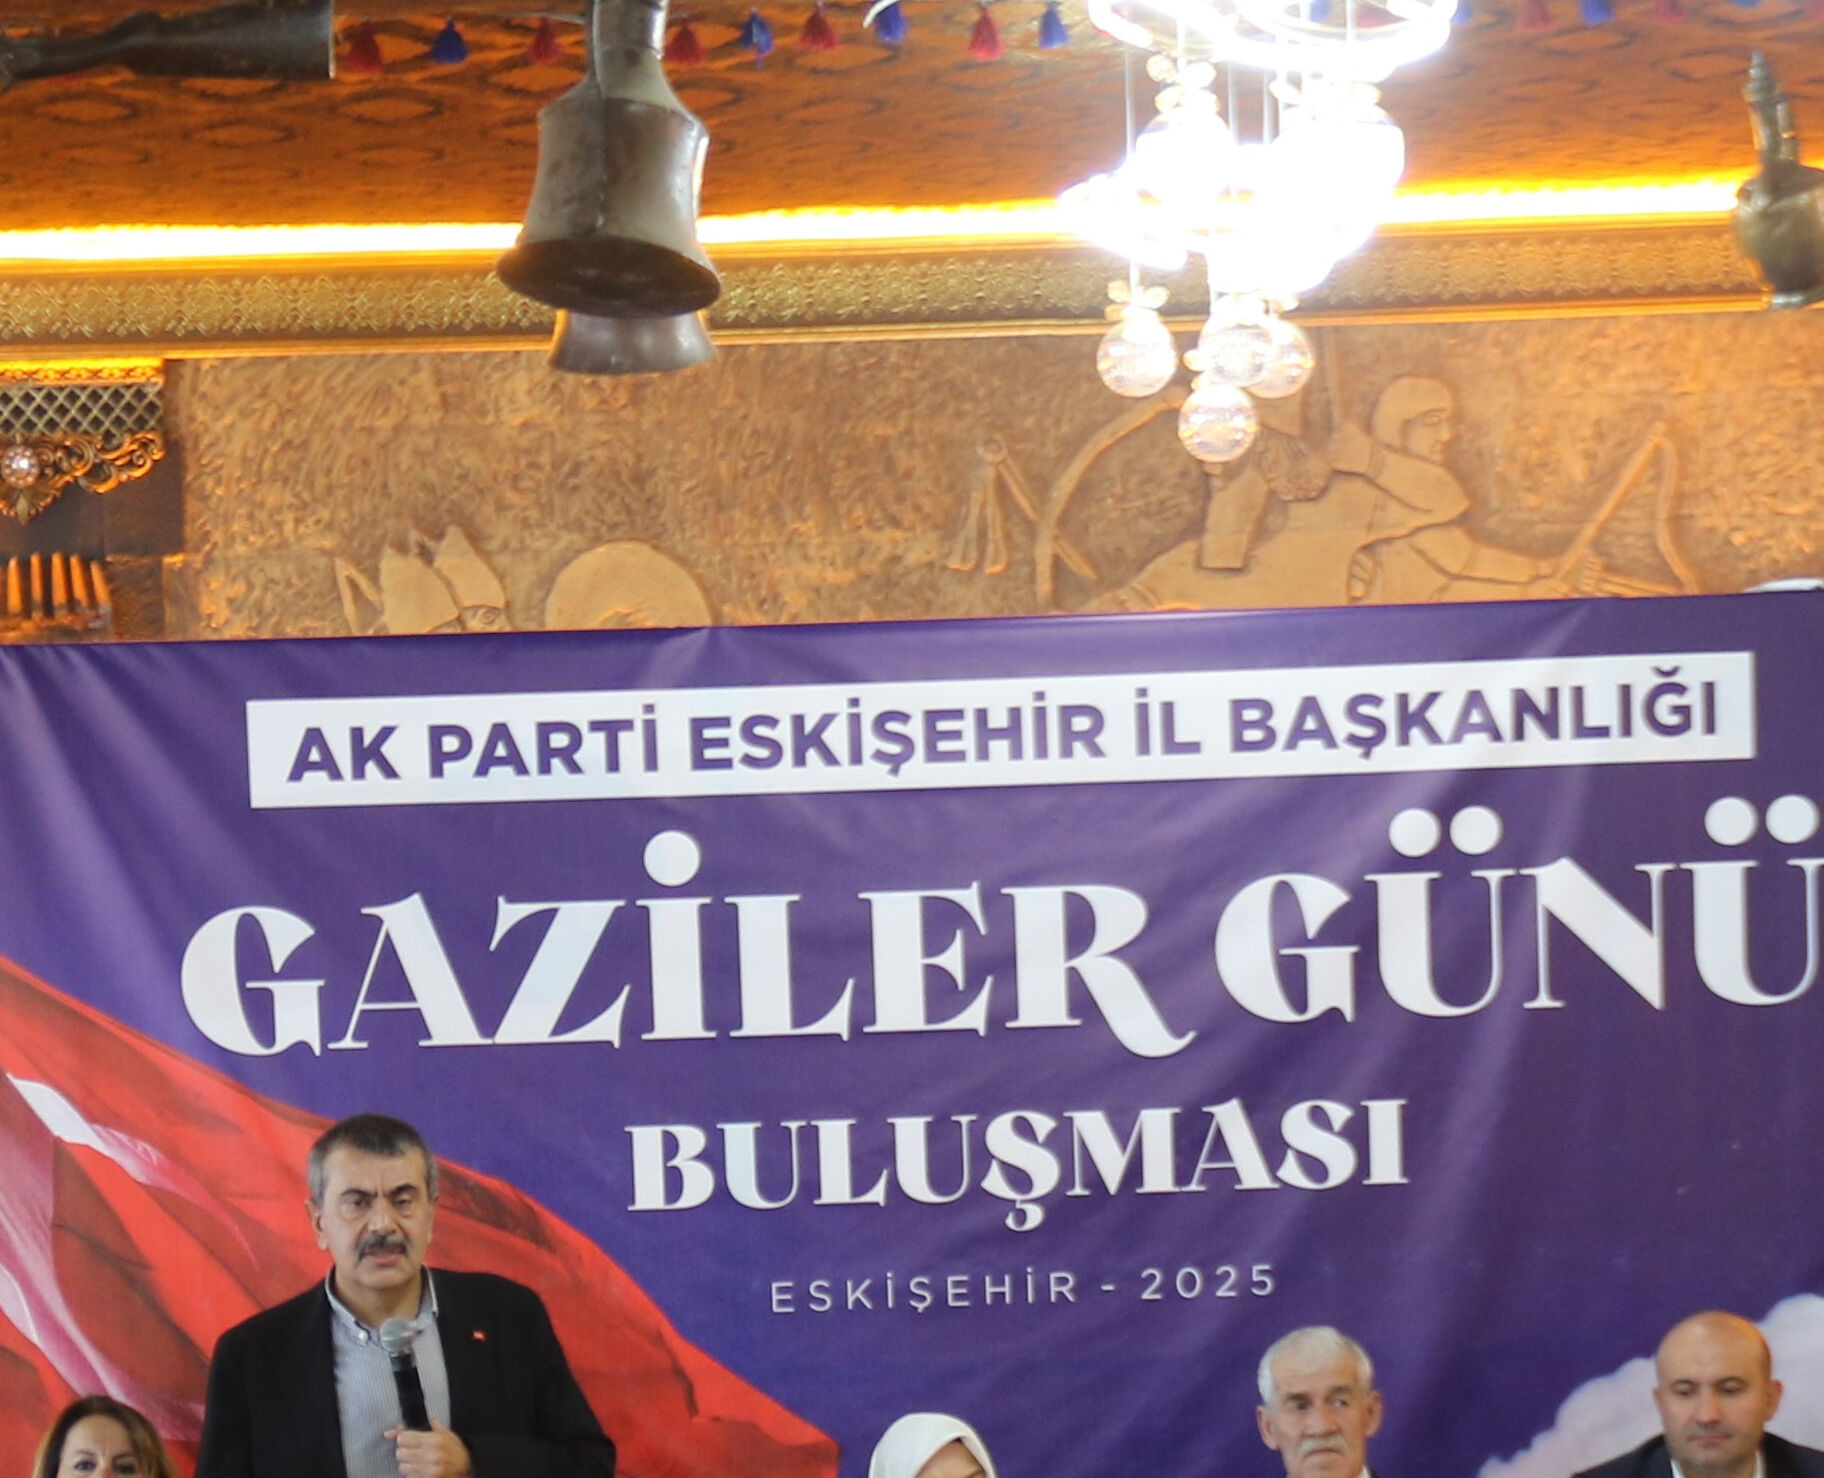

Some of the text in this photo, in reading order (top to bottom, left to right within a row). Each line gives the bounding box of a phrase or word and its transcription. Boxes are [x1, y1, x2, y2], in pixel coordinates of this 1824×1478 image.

[287, 666, 1718, 783] AK PARTİ ESKİŞEHİR İL BAŞKANLIĞI
[180, 830, 1197, 1059] GAZİLER
[624, 1097, 1411, 1233] BULUŞMASI
[770, 1267, 1079, 1315] ESKİŞEHİR
[1139, 1264, 1277, 1301] 2025
